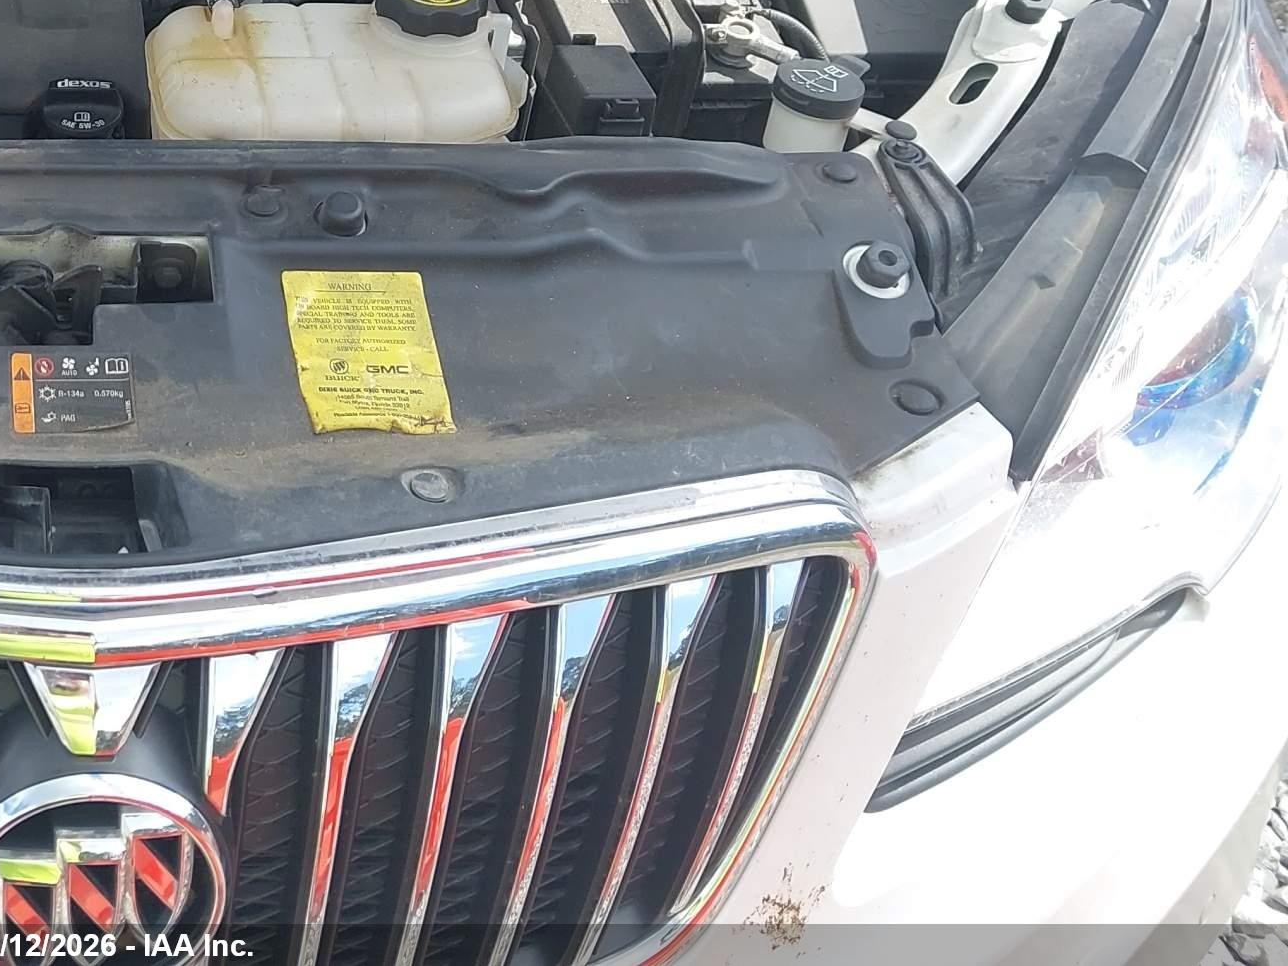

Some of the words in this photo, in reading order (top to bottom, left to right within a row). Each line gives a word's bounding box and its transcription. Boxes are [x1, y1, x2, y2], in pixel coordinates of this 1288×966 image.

[56, 78, 112, 89] dexos
[60, 119, 77, 129] SAE
[78, 119, 106, 129] 5W-30
[327, 282, 372, 291] WARNING
[365, 365, 409, 374] GMC
[58, 389, 85, 398] R-134a
[94, 389, 124, 398] 0.570kg
[60, 414, 76, 422] PAG
